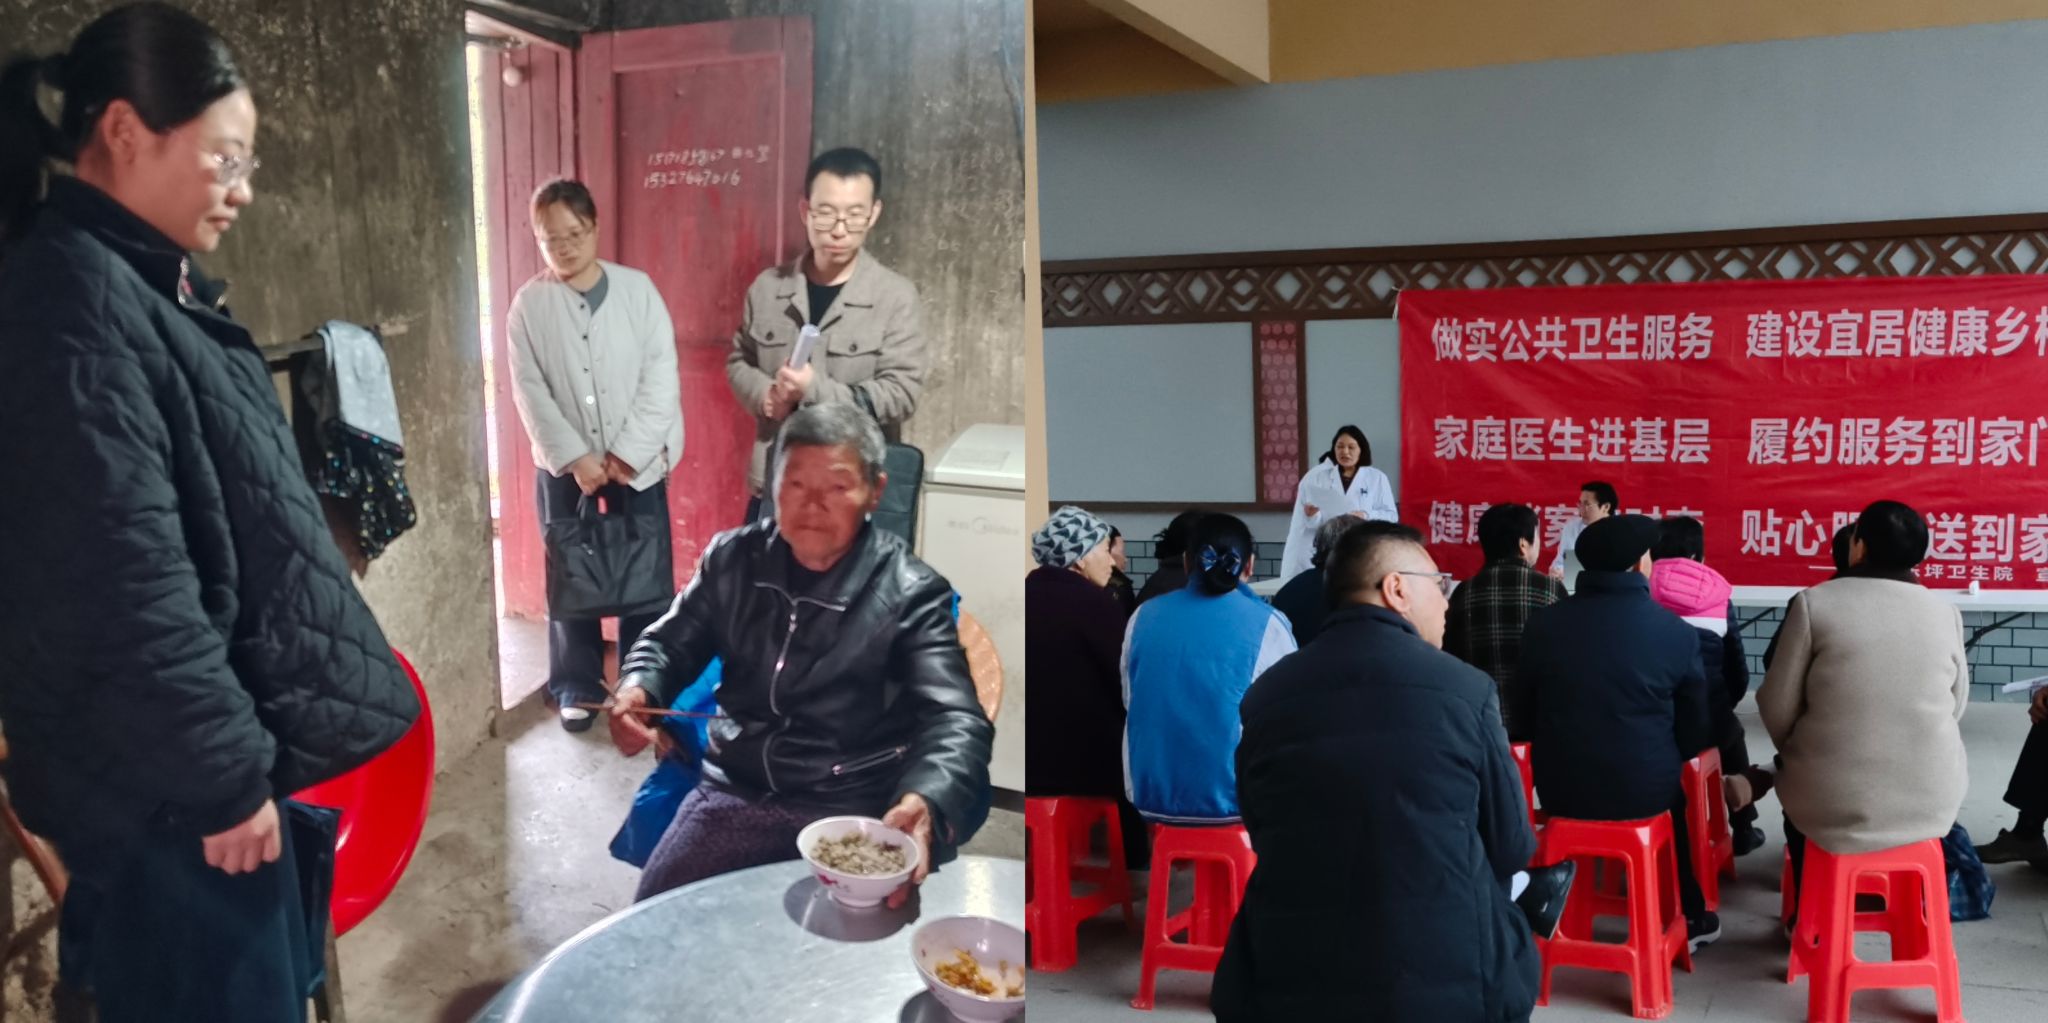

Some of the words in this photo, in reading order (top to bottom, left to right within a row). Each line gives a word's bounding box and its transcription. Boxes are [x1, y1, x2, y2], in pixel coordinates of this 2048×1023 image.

[1431, 312, 1714, 363] 做实公共卫生服务
[1434, 415, 1711, 463] 家庭医生进基层
[1740, 508, 2048, 564] 贴心送到家
